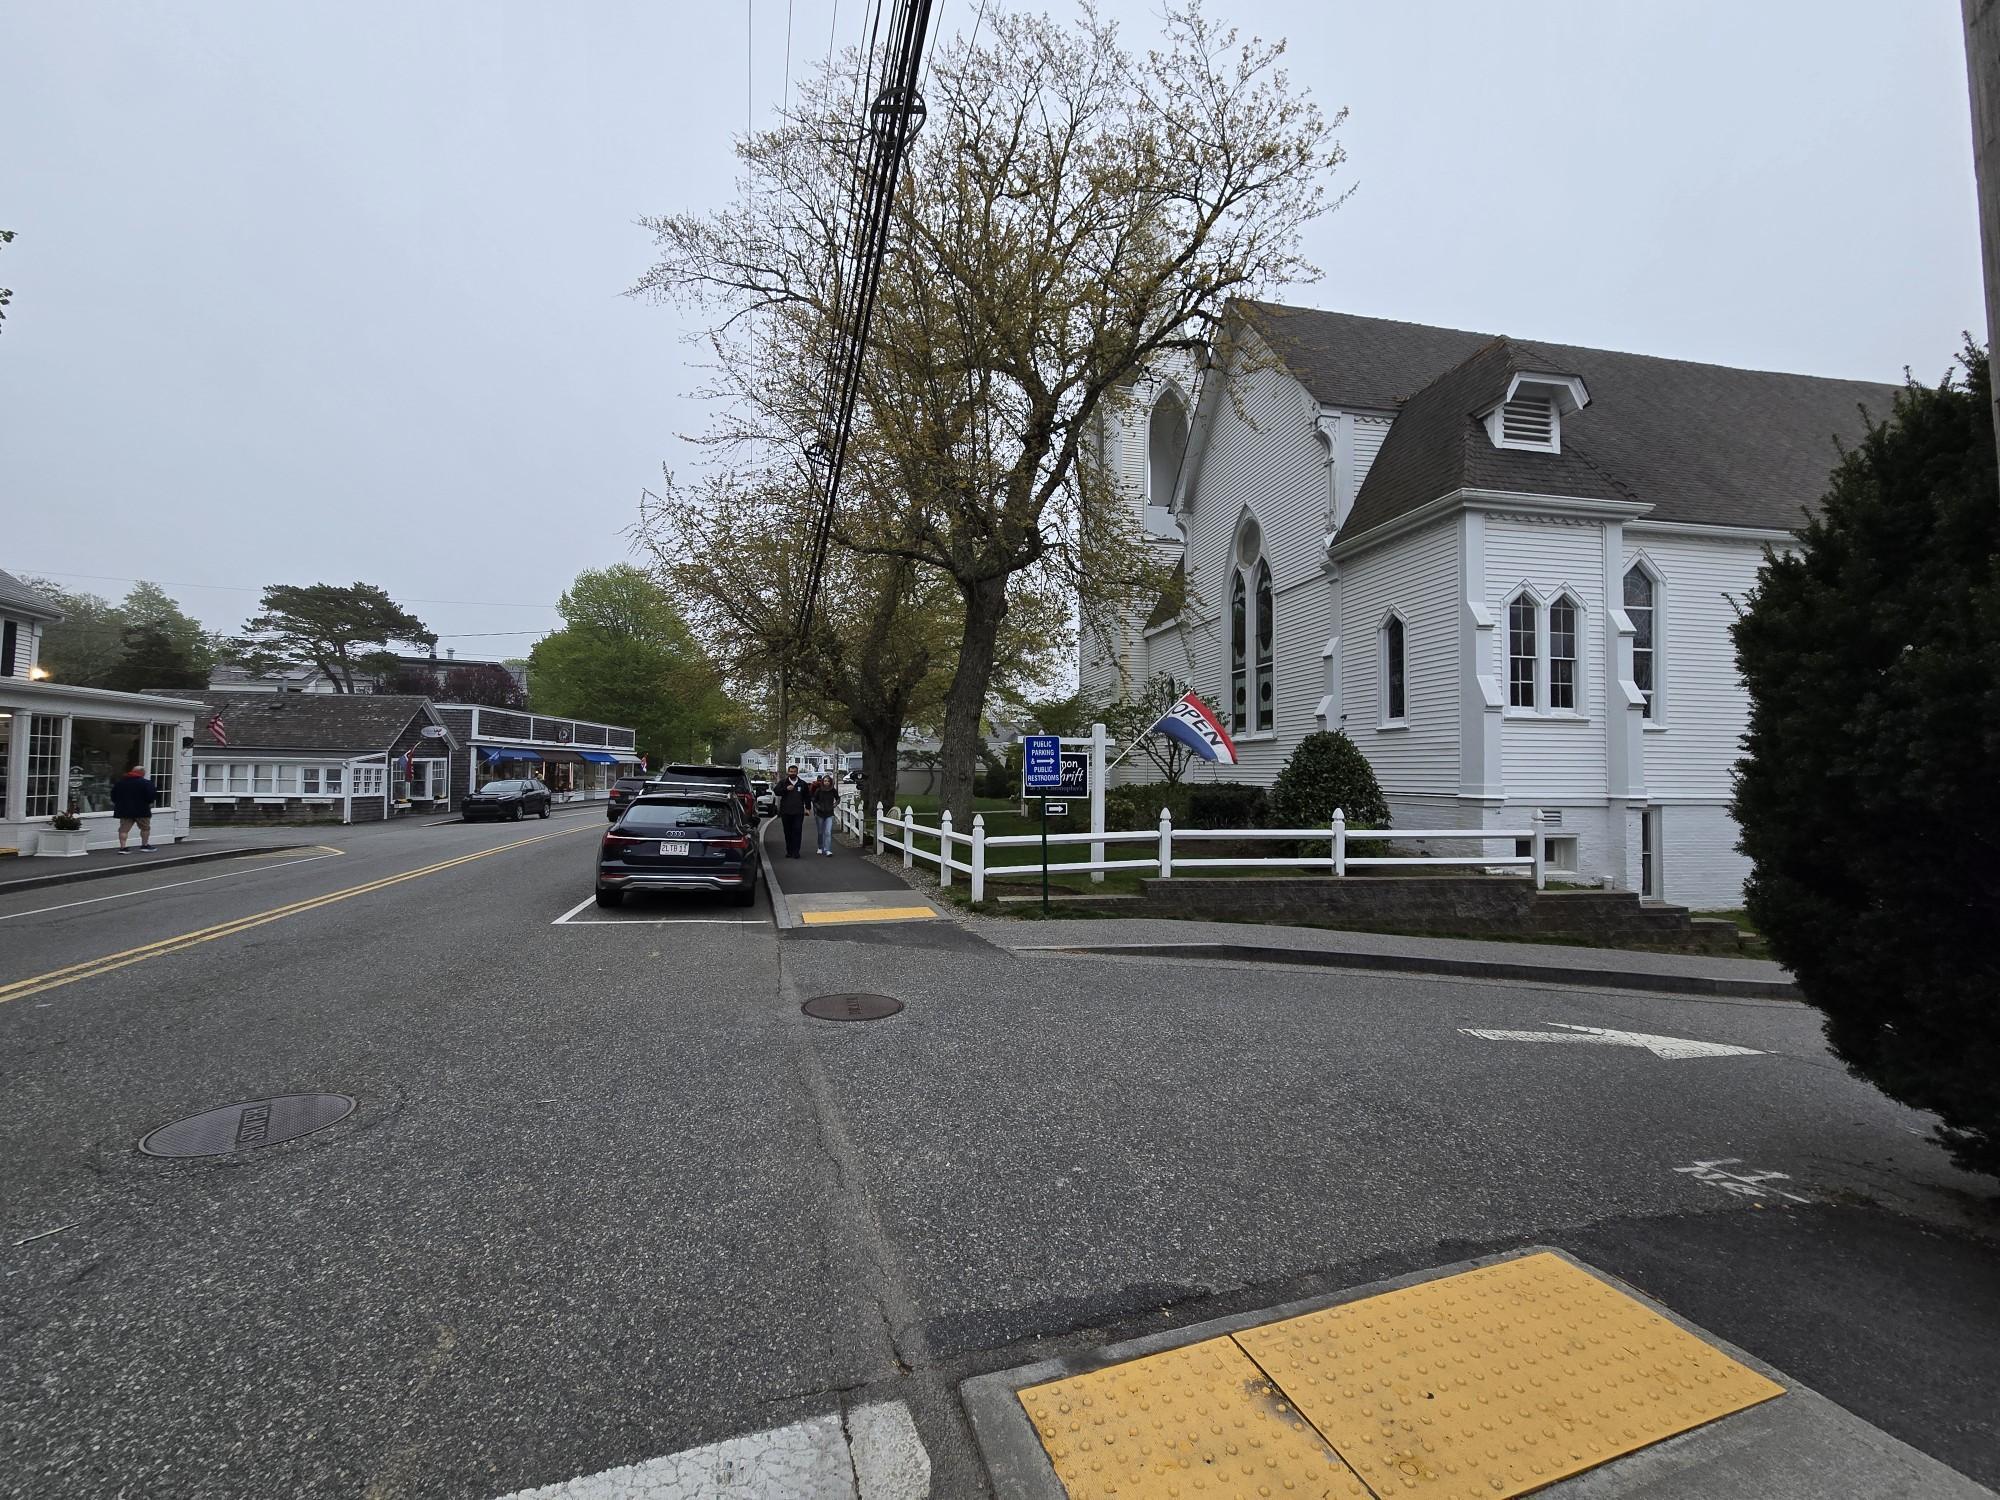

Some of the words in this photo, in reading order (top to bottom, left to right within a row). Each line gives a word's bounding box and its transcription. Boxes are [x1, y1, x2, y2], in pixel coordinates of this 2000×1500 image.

[1172, 704, 1224, 746] OPEN
[1033, 740, 1052, 748] PUBLIC
[1031, 749, 1055, 757] PARKING
[1030, 757, 1036, 765] &
[1060, 760, 1078, 768] mon
[1027, 774, 1060, 782] RESTROOMS
[1060, 767, 1084, 786] hrift
[239, 1106, 268, 1142] SEWER
